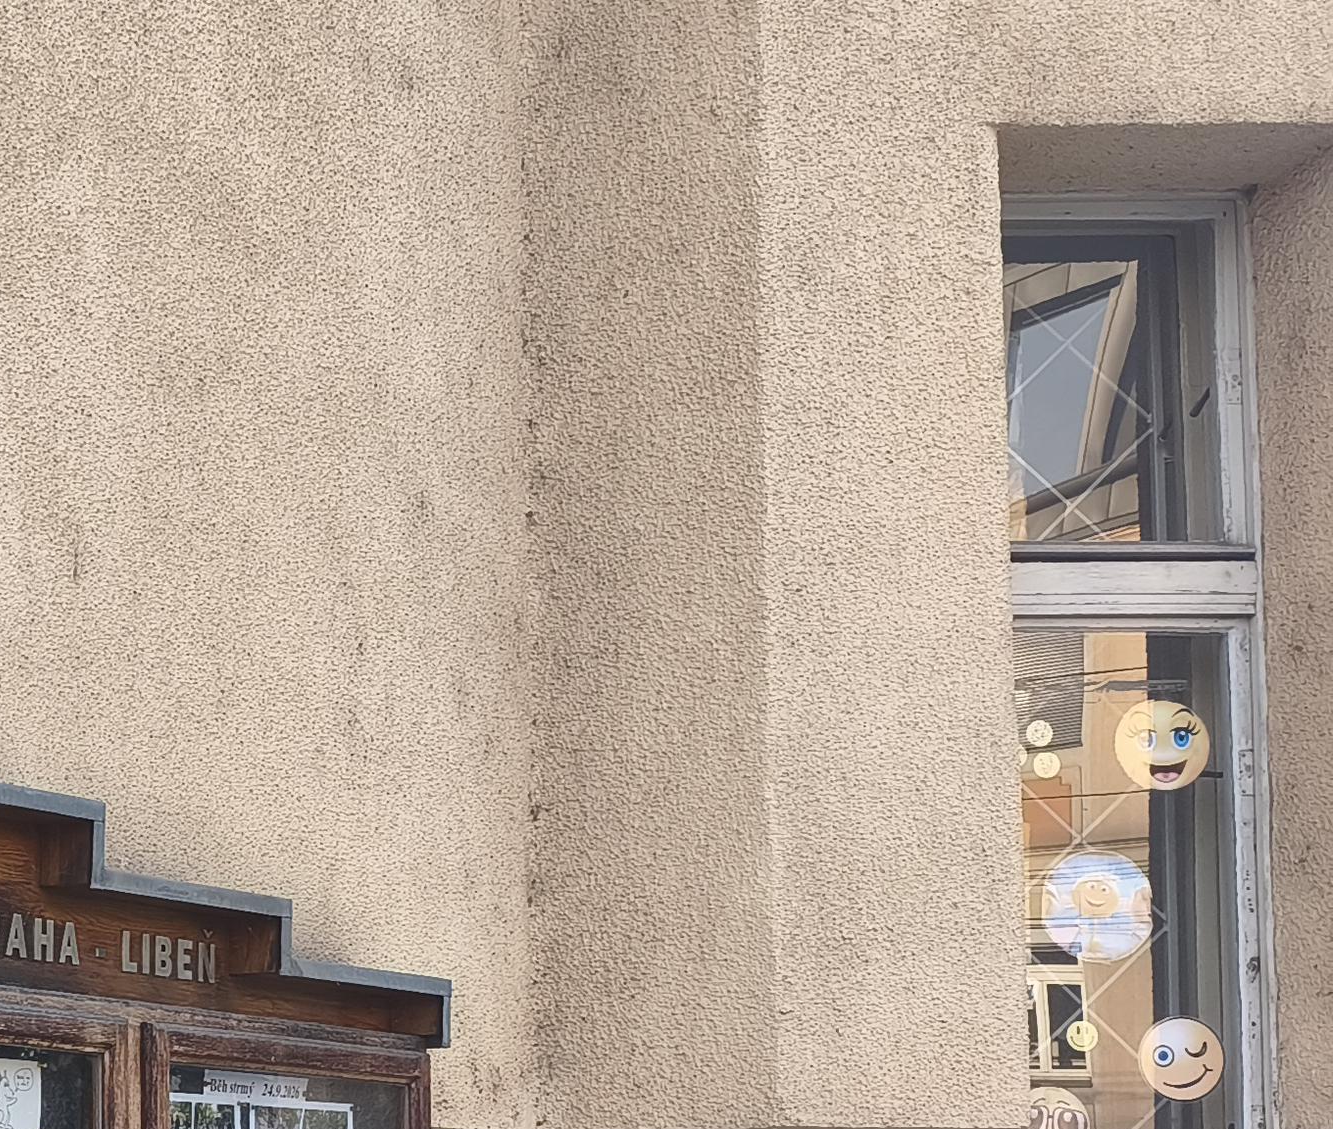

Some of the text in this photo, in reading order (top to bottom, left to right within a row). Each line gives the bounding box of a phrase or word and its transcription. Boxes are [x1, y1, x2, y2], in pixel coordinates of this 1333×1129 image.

[122, 929, 216, 984] LIBEŇ
[210, 1079, 227, 1093] Běh
[229, 1081, 256, 1098] strmý
